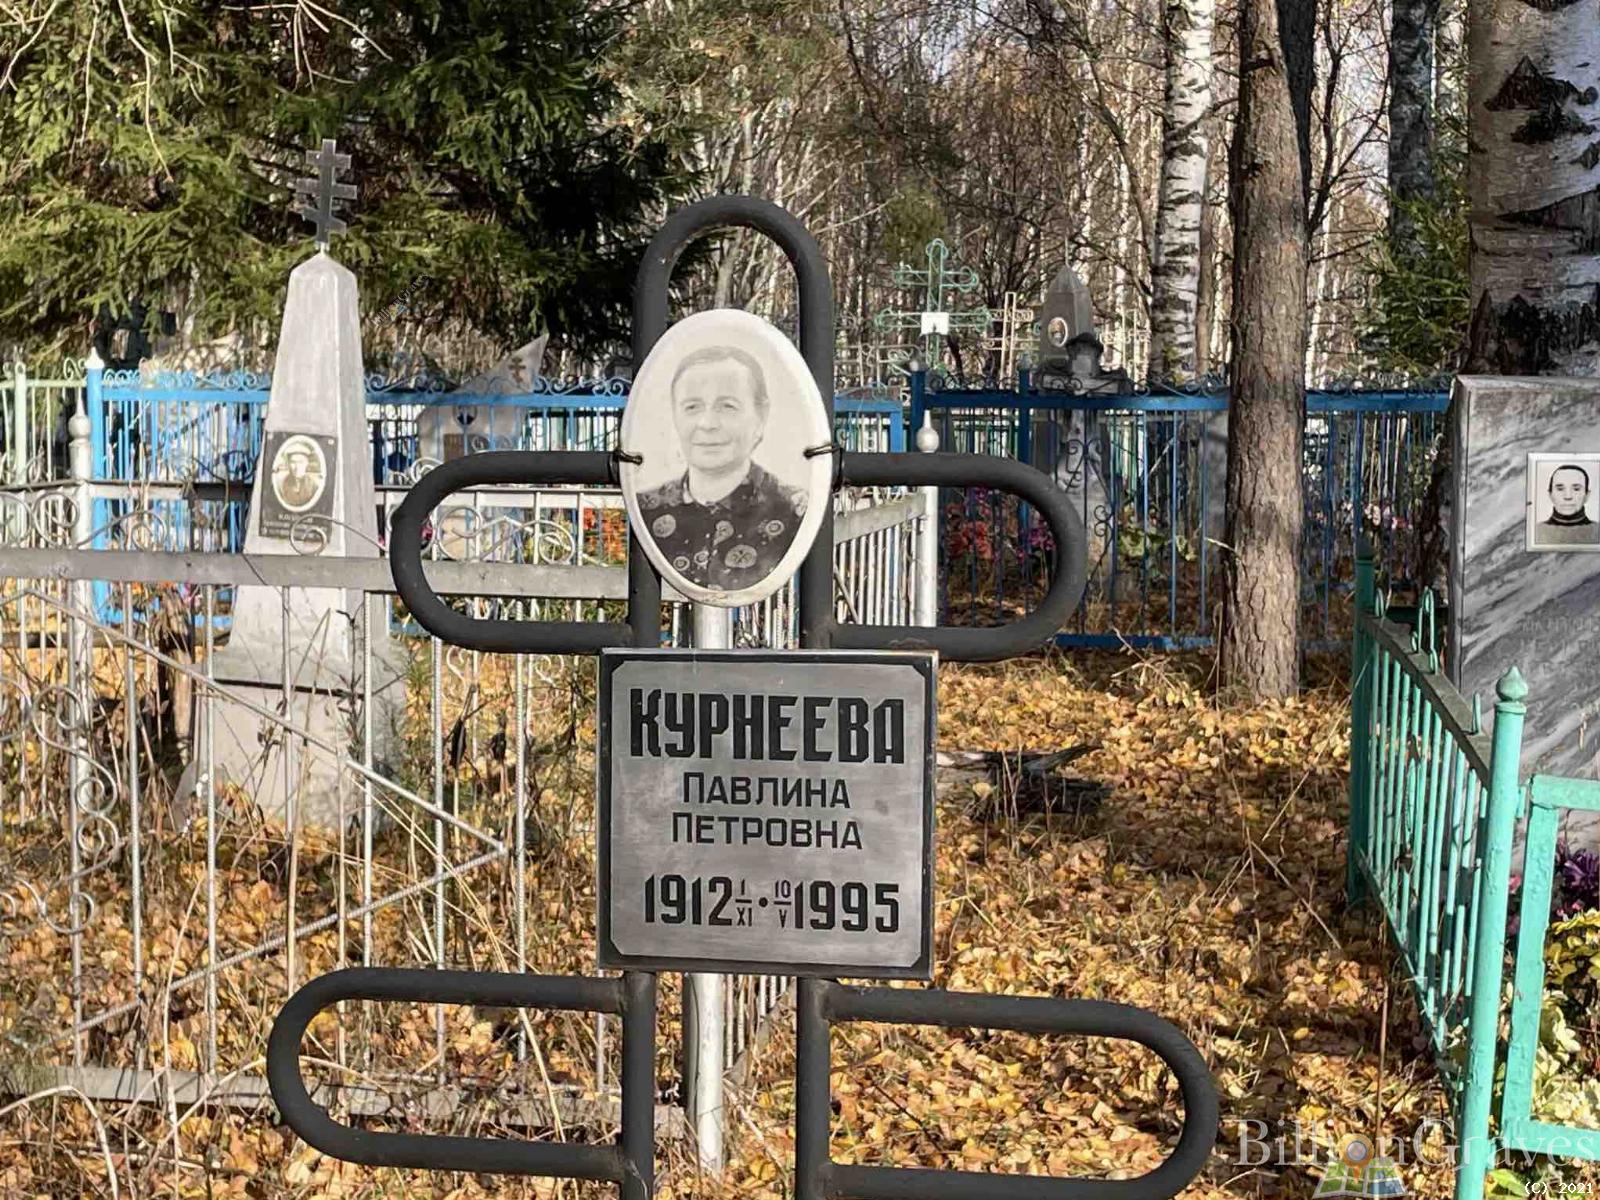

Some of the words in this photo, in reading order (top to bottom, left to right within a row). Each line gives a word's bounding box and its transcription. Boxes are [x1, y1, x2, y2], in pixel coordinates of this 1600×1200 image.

[630, 688, 905, 764] КУРНЕЕВА
[683, 772, 851, 809] ПАВЛИНА
[672, 812, 862, 849] ПЕТРОВНА
[645, 874, 733, 926] 1912
[794, 880, 900, 933] 1995
